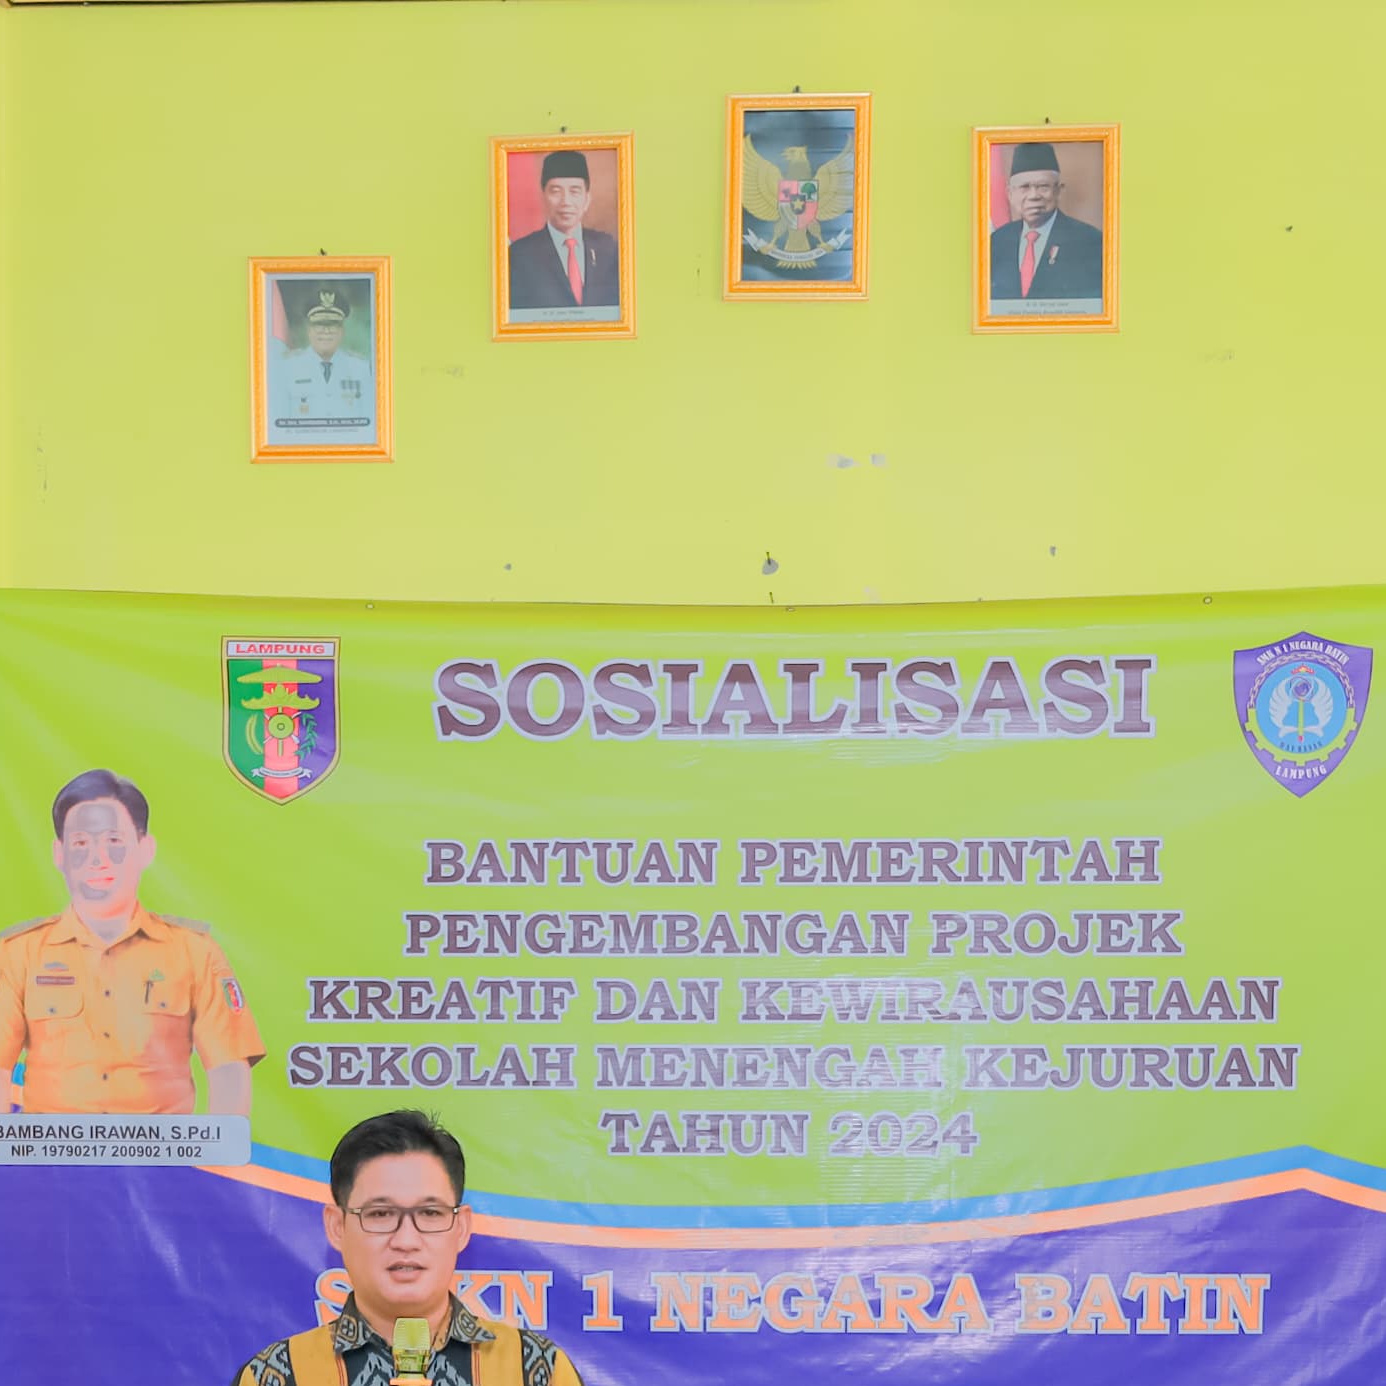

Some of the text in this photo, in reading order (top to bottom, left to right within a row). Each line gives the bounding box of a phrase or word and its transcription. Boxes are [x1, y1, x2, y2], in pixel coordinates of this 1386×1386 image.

[235, 644, 326, 654] LAMPUNG
[1289, 640, 1325, 652] NEGARA
[433, 655, 1156, 741] SOSIALISASI
[1275, 764, 1328, 779] LAMPUNG
[424, 838, 1162, 886] BANTUAN PEMERINTAH
[402, 910, 1184, 956] PENGEMBANGAN PROJEK
[307, 977, 1281, 1023] KREATIF DAN KEWIRAUSAHAAN
[288, 1043, 1300, 1090] SEKOLAH MENENGAH KEJURUAN
[11, 1145, 203, 1158] NIP. 19790217 200902 1 002
[89, 1125, 166, 1142] IRAWAN,
[170, 1125, 221, 1140] S.Pd.I
[599, 1111, 979, 1157] TAHUN 2024
[314, 1268, 1271, 1336] SKN 1 NEGARA BATIN
